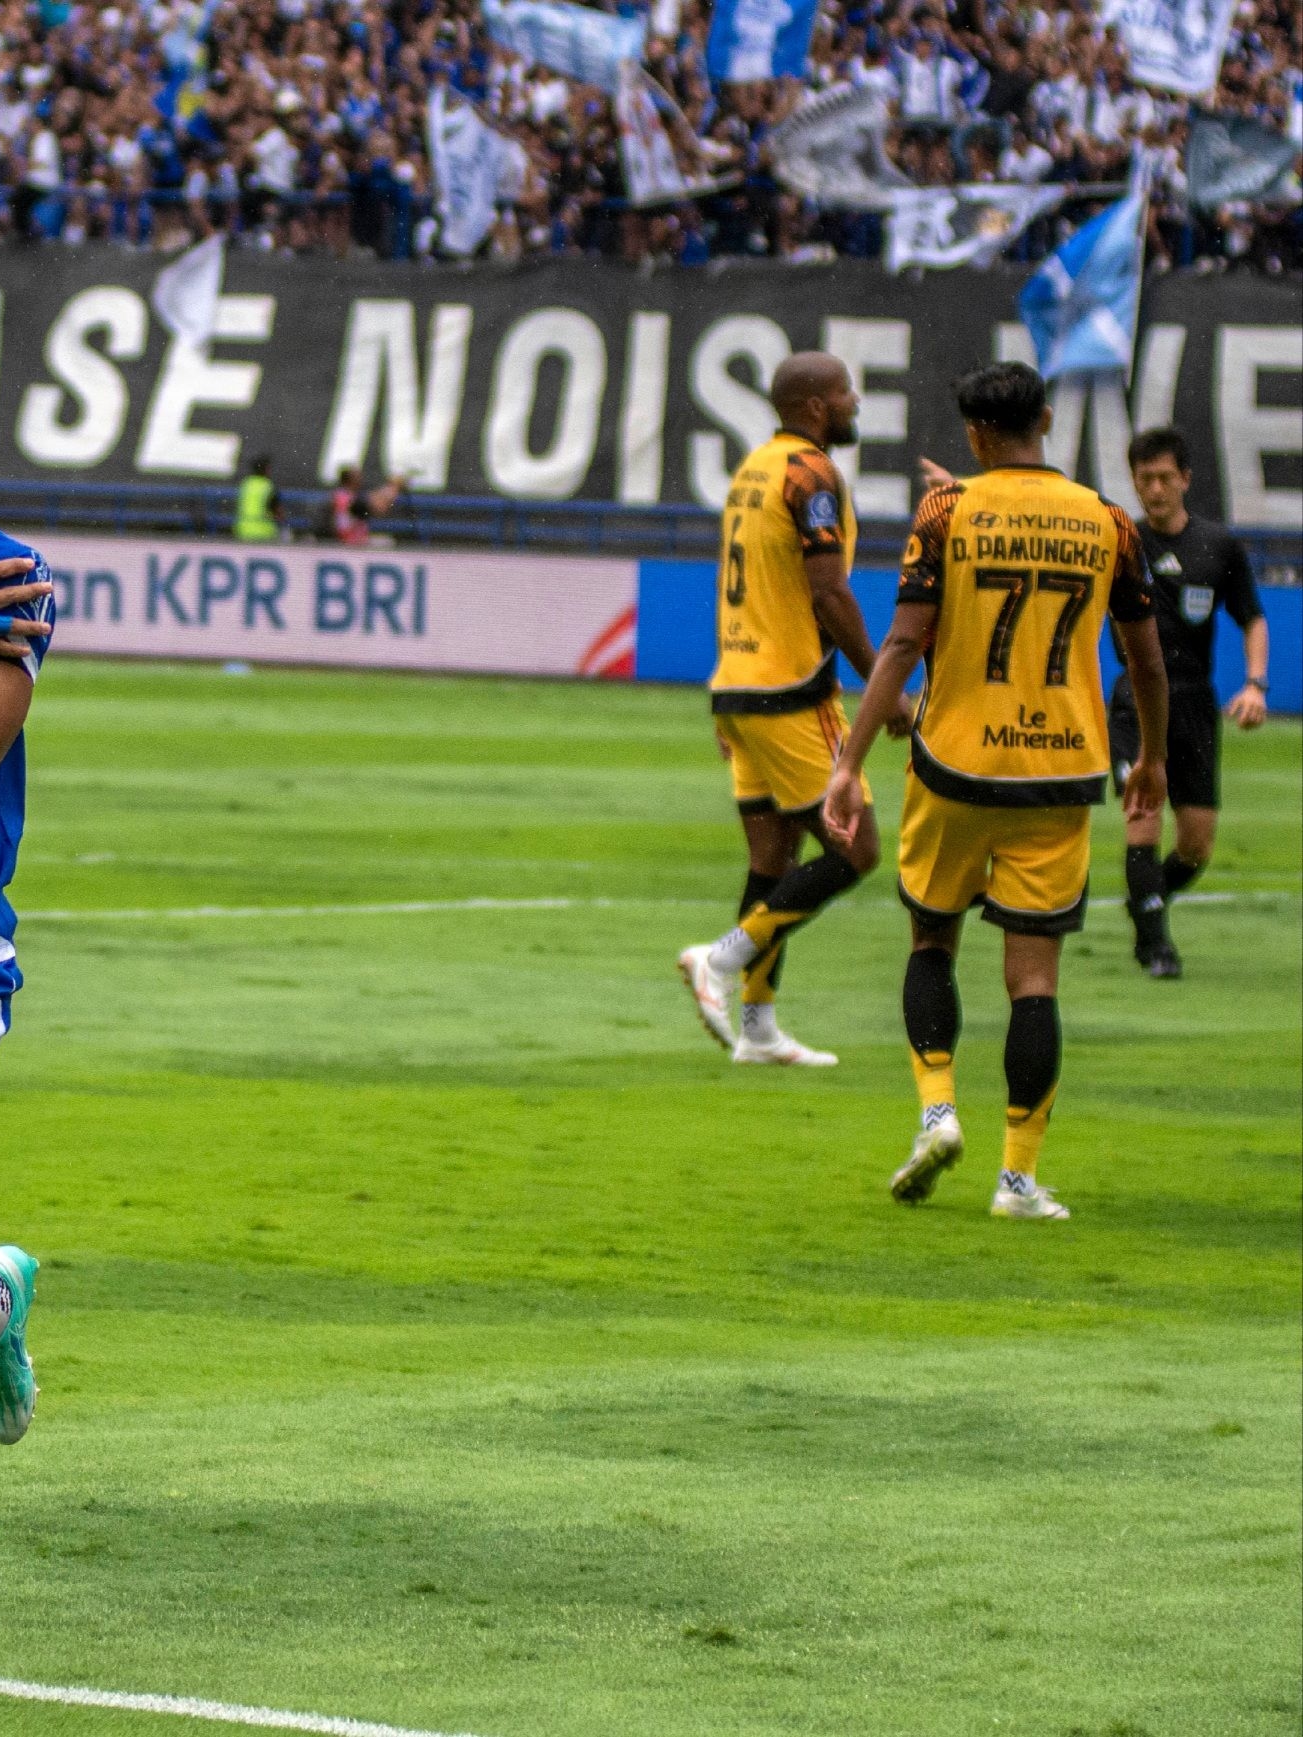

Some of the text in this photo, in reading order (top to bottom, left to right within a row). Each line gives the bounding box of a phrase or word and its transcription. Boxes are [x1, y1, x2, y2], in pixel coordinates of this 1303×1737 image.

[318, 297, 913, 520] NOISE
[952, 535, 1111, 573] D. PAMUNGKAS
[1008, 513, 1102, 537] HYUNDAI
[726, 513, 746, 608] 6
[145, 553, 288, 630] KPR
[314, 560, 428, 637] BRI
[975, 567, 1096, 687] 77
[982, 724, 1085, 751] Minerale
[1019, 704, 1047, 729] Le
